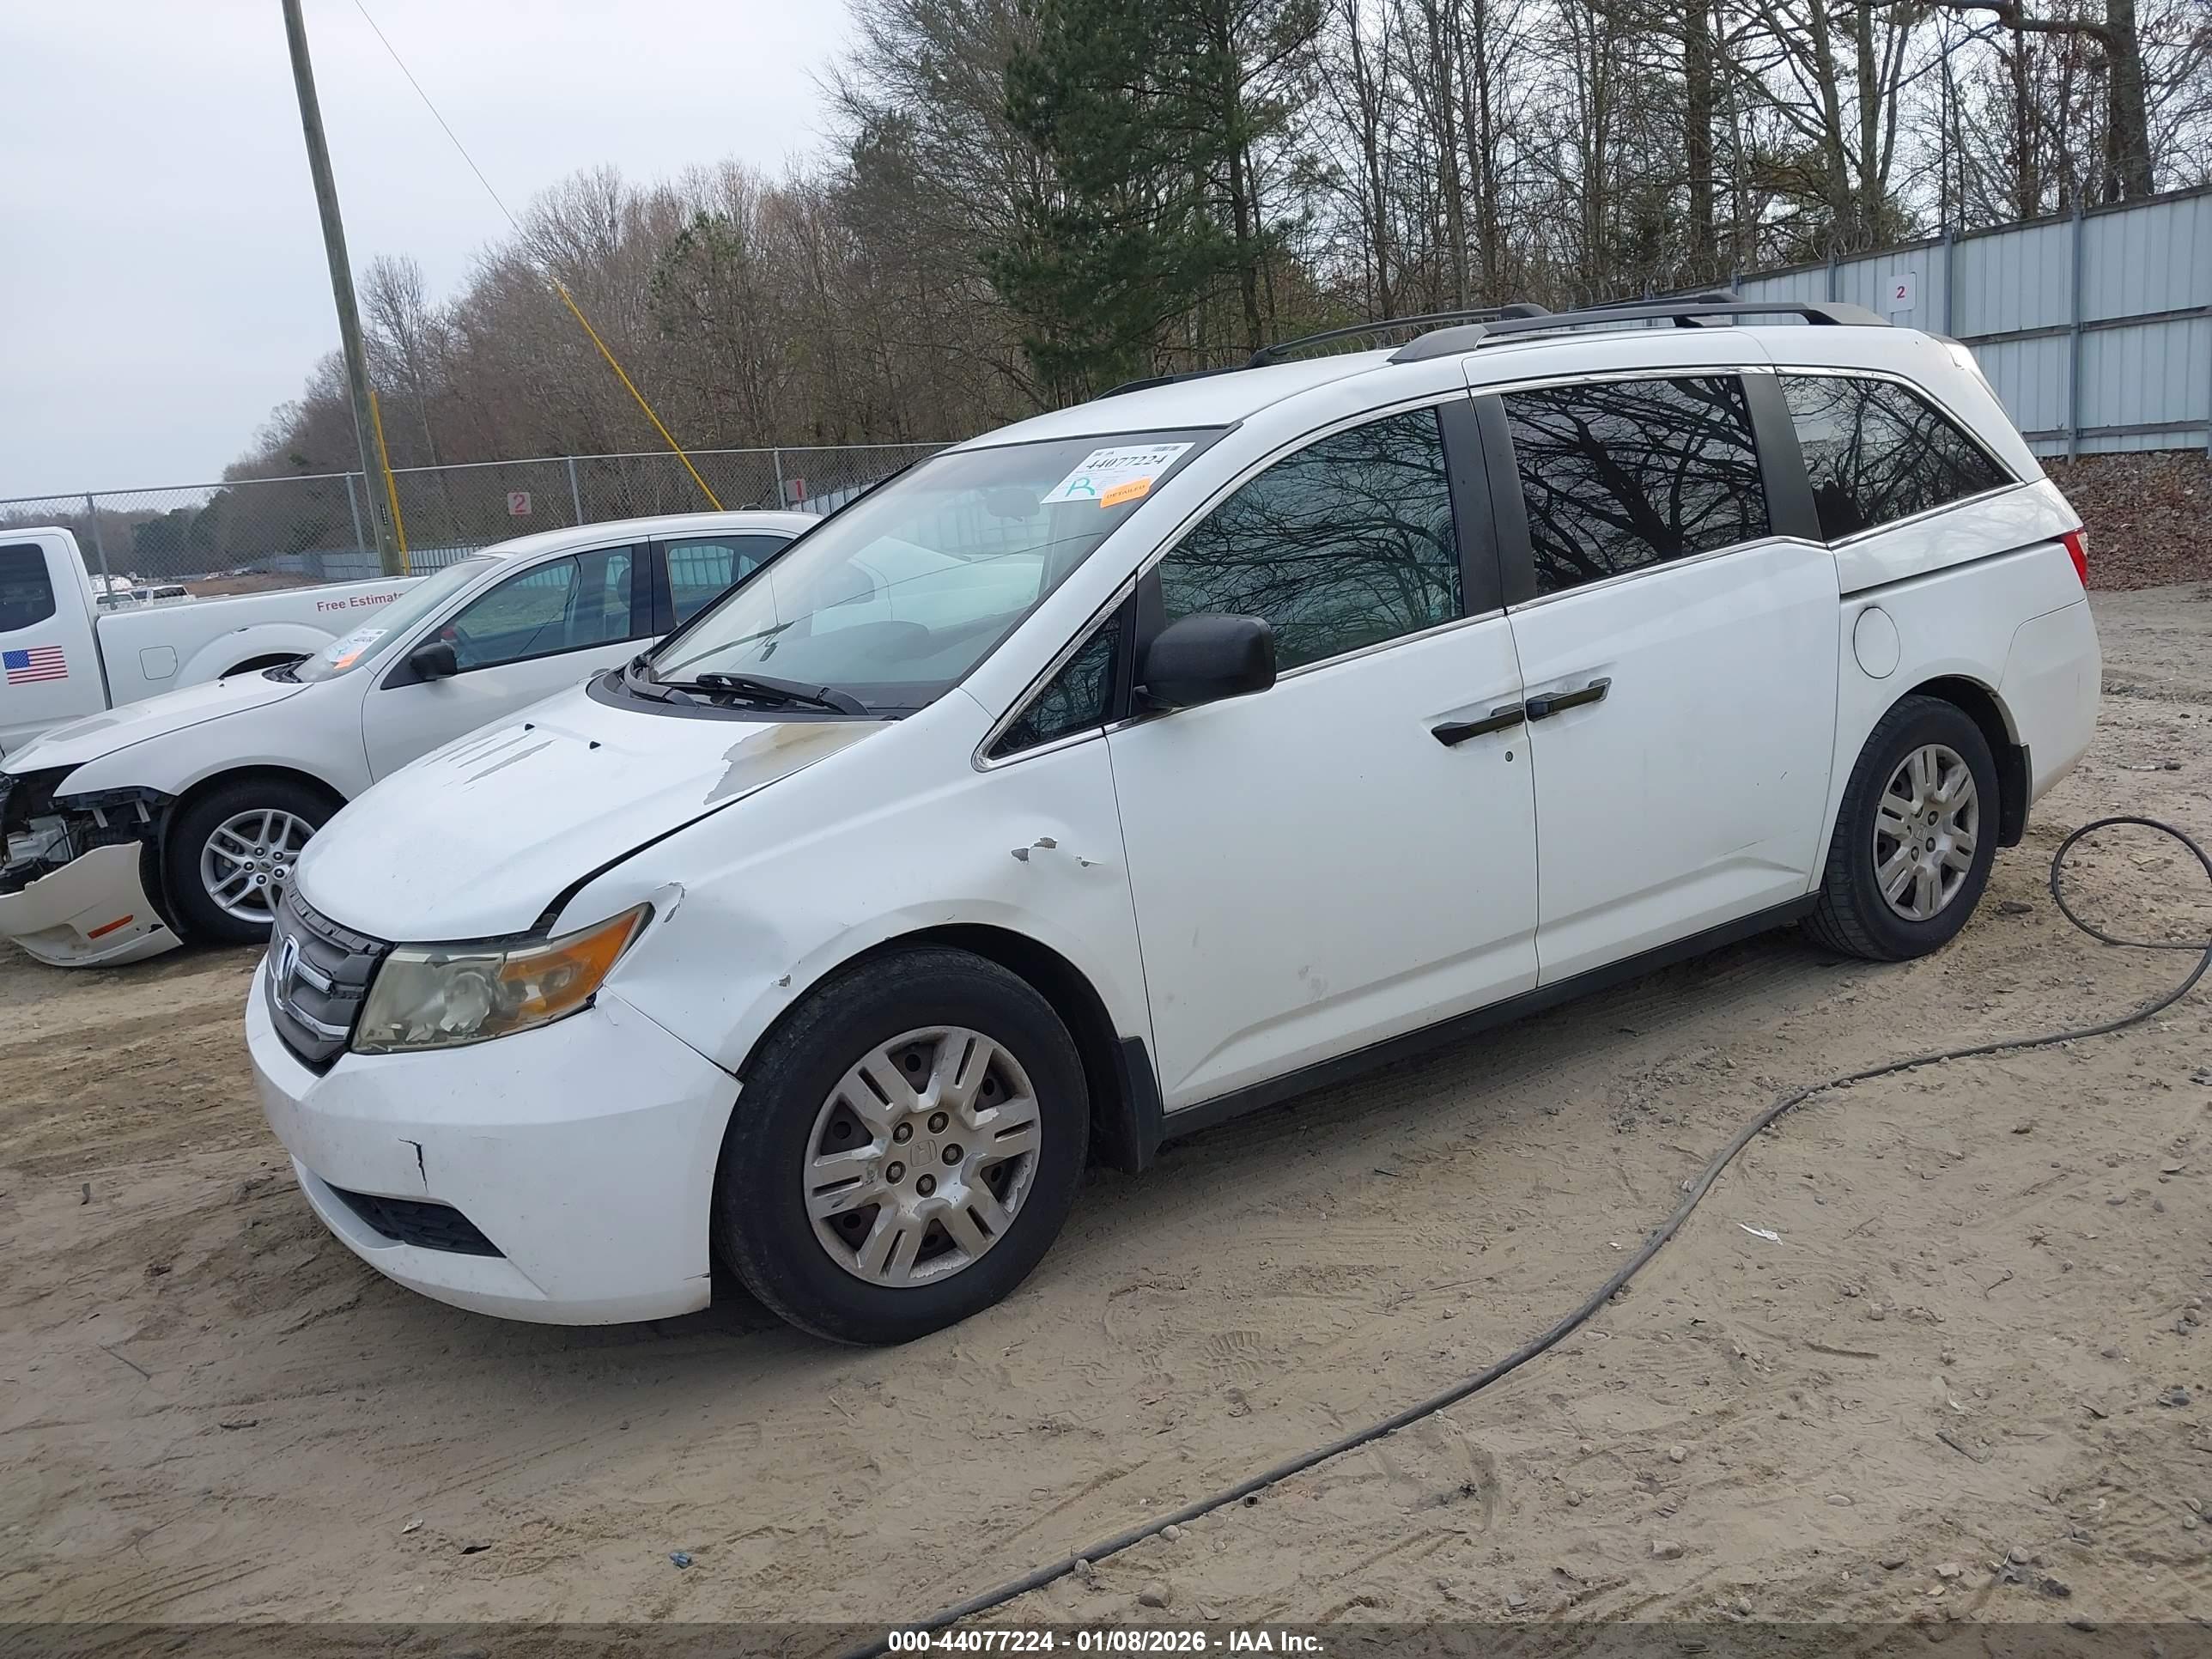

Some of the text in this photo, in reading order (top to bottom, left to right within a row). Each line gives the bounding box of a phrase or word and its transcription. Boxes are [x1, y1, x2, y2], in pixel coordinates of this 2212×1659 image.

[1896, 285, 1905, 299] 2
[1086, 454, 1169, 470] 44077224
[796, 480, 802, 498] 1
[514, 494, 526, 513] 2
[316, 601, 346, 612] Free
